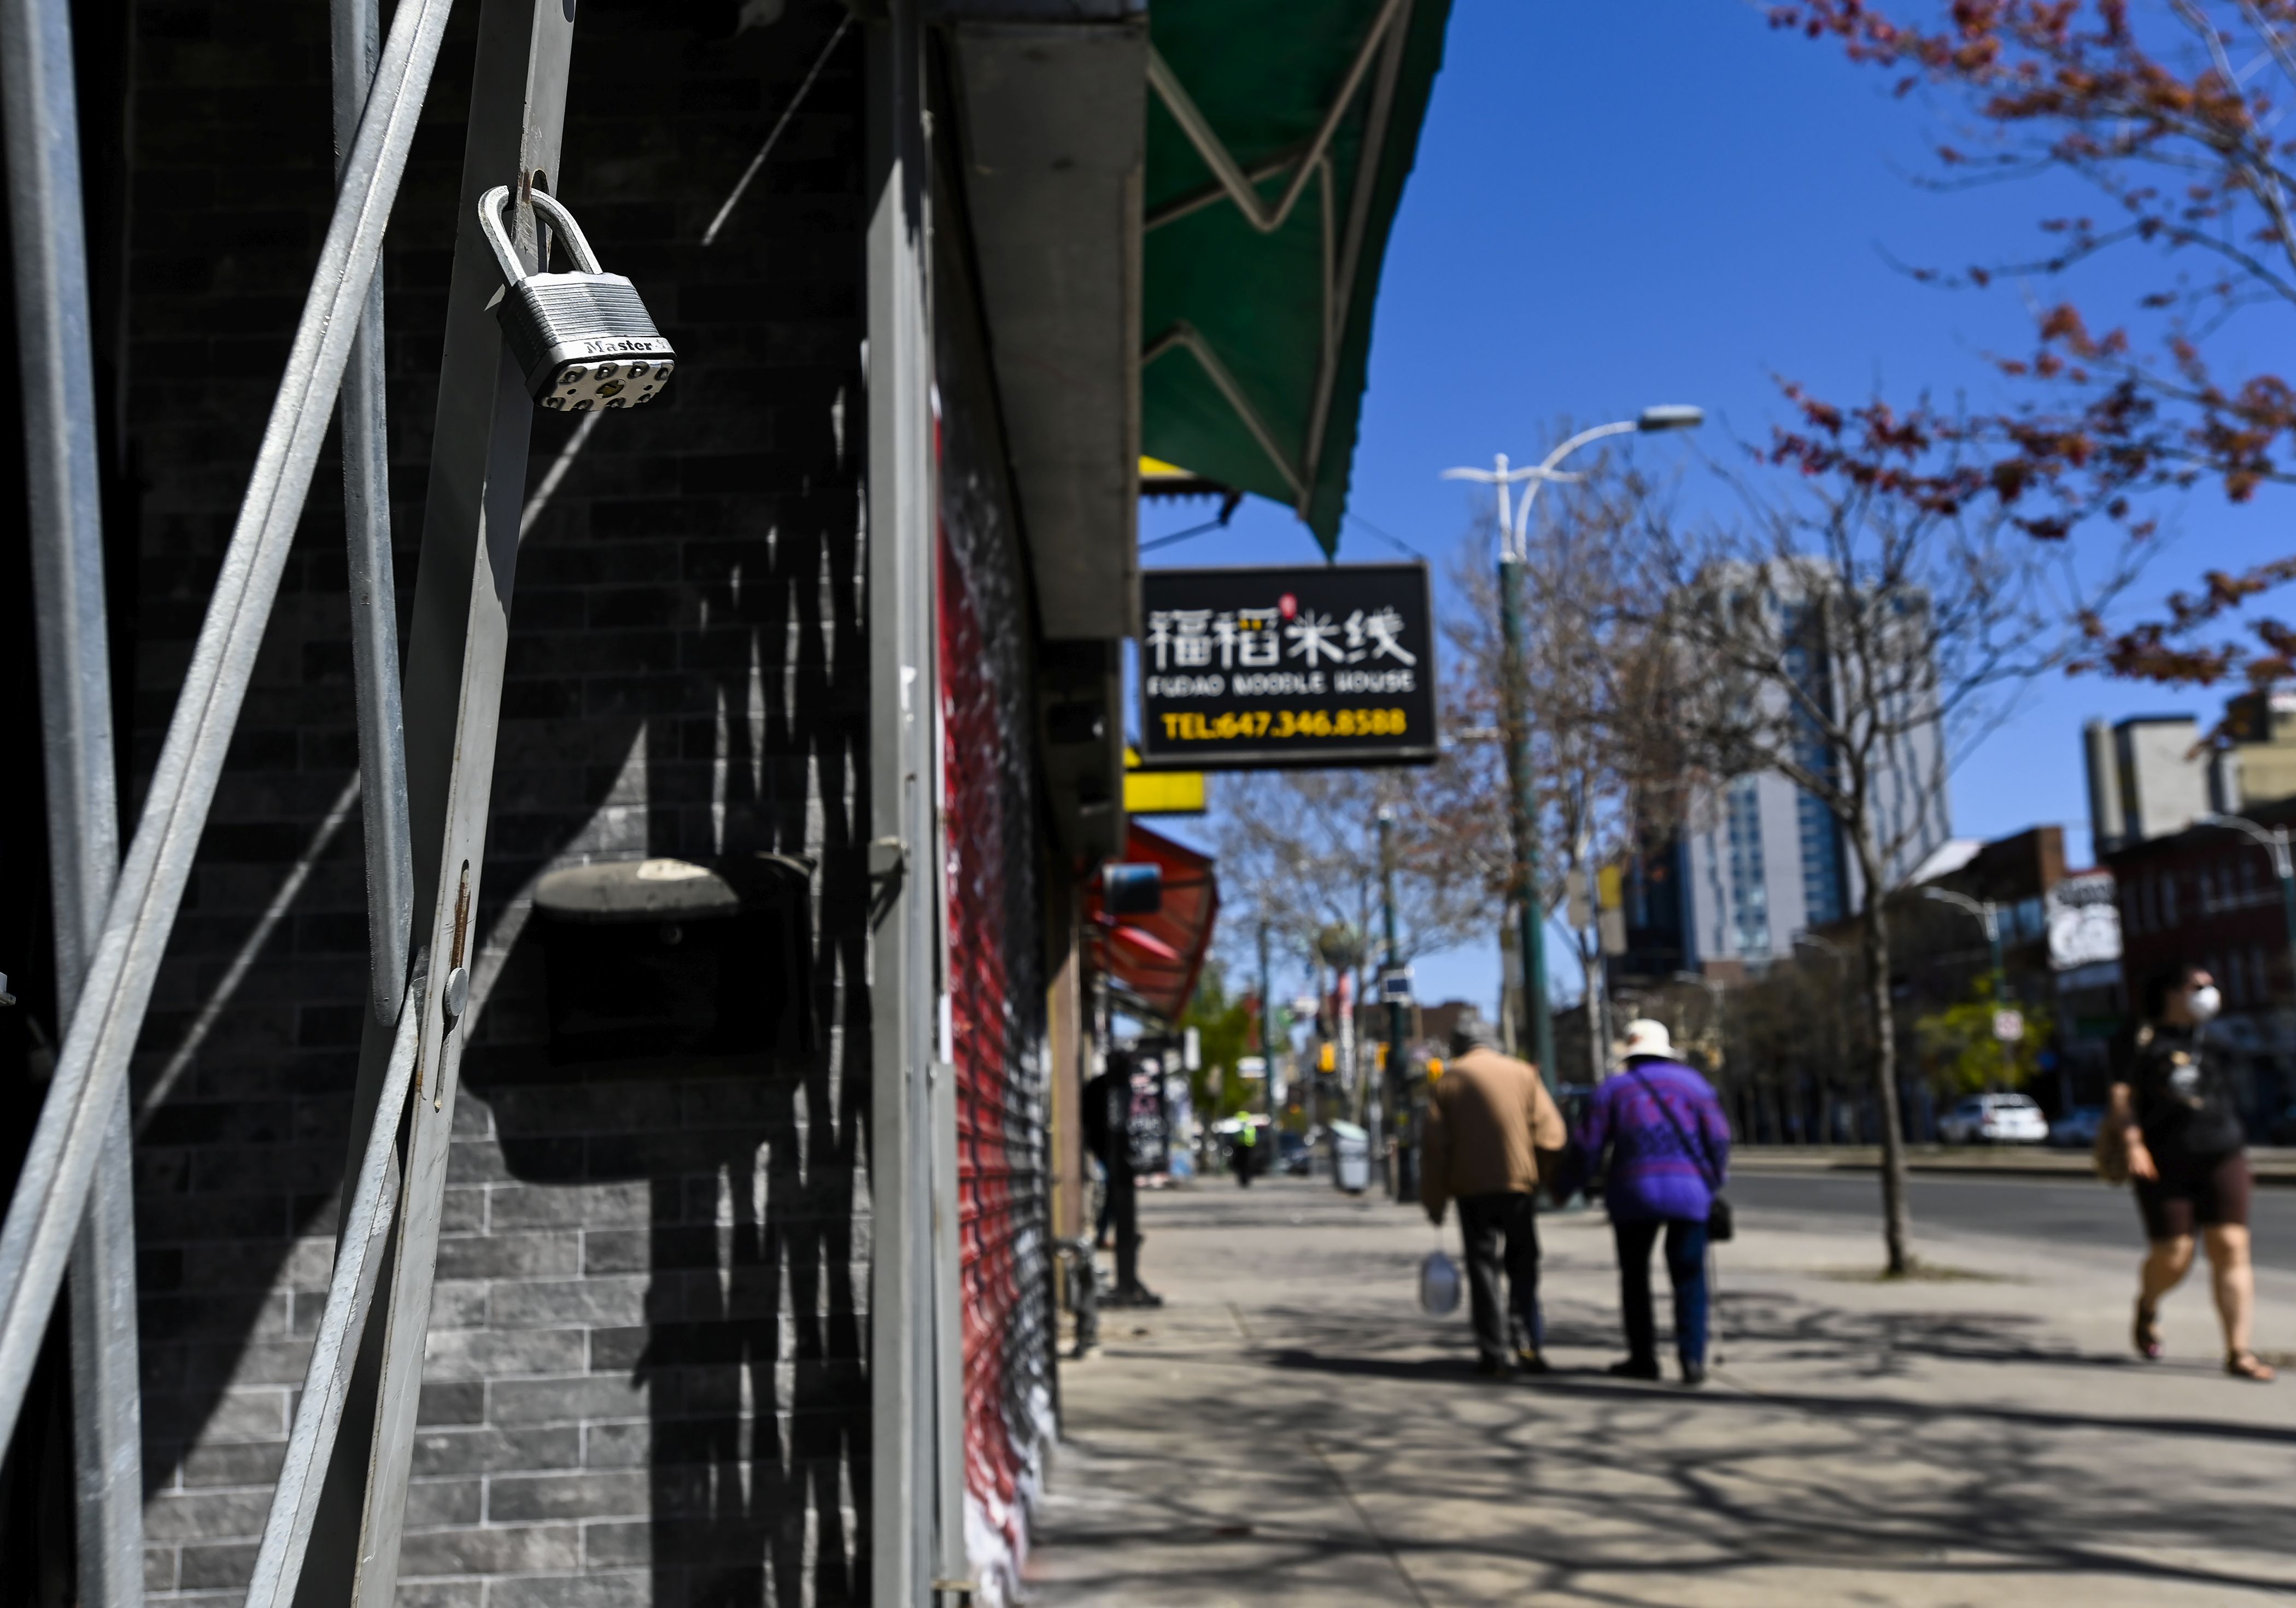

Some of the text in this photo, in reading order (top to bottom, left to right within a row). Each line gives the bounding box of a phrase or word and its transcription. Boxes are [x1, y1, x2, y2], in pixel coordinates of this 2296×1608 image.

[584, 340, 652, 354] Master
[1146, 668, 1415, 697] FUDAO NOODLE HOUSE
